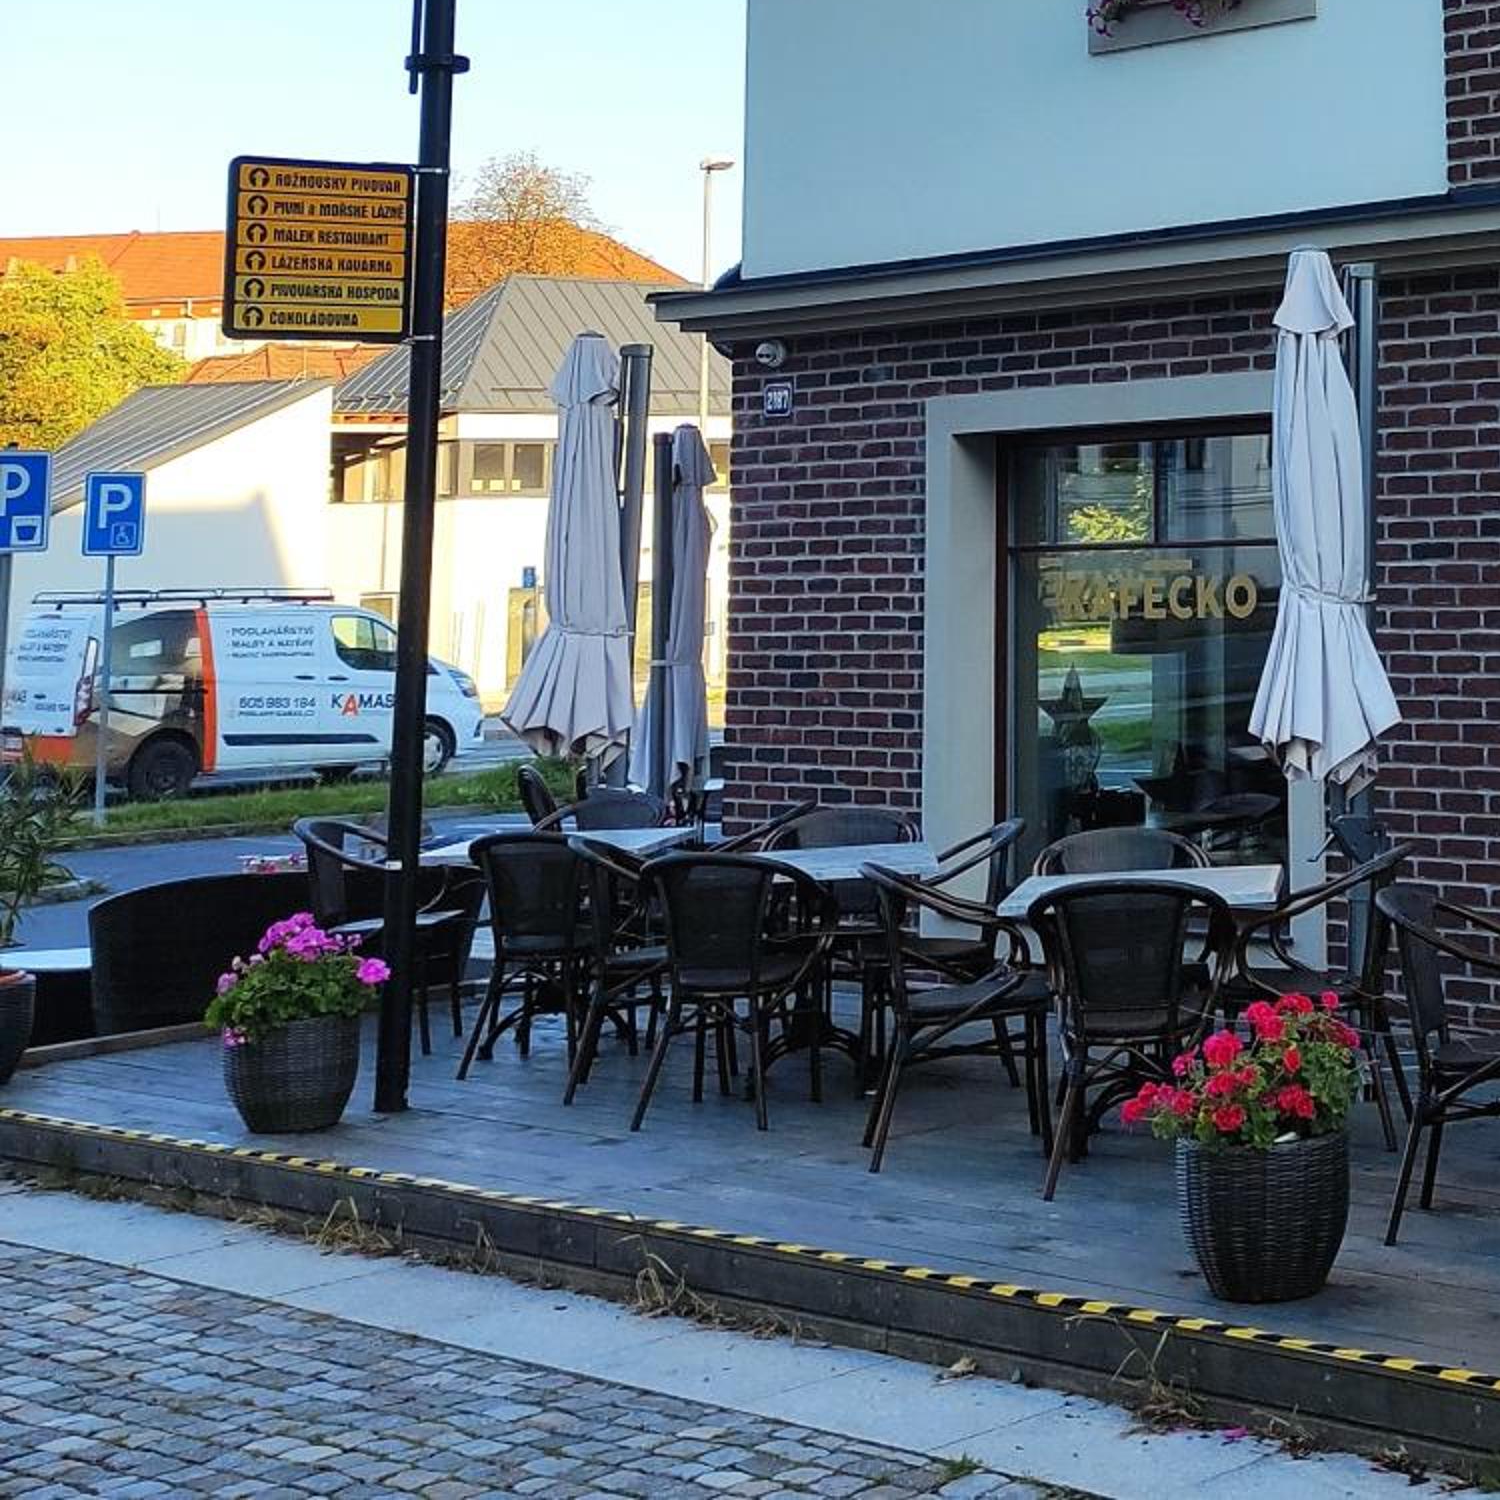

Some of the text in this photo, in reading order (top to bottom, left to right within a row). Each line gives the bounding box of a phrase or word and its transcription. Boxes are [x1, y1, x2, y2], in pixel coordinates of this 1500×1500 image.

[351, 177, 401, 193] PIVOVAR
[318, 231, 389, 246] RESTAURANT
[347, 286, 400, 300] HOSPODA
[0, 463, 31, 517] P
[98, 483, 133, 529] P
[1056, 573, 1258, 620] KAFECKO
[331, 693, 395, 715] KAMAS
